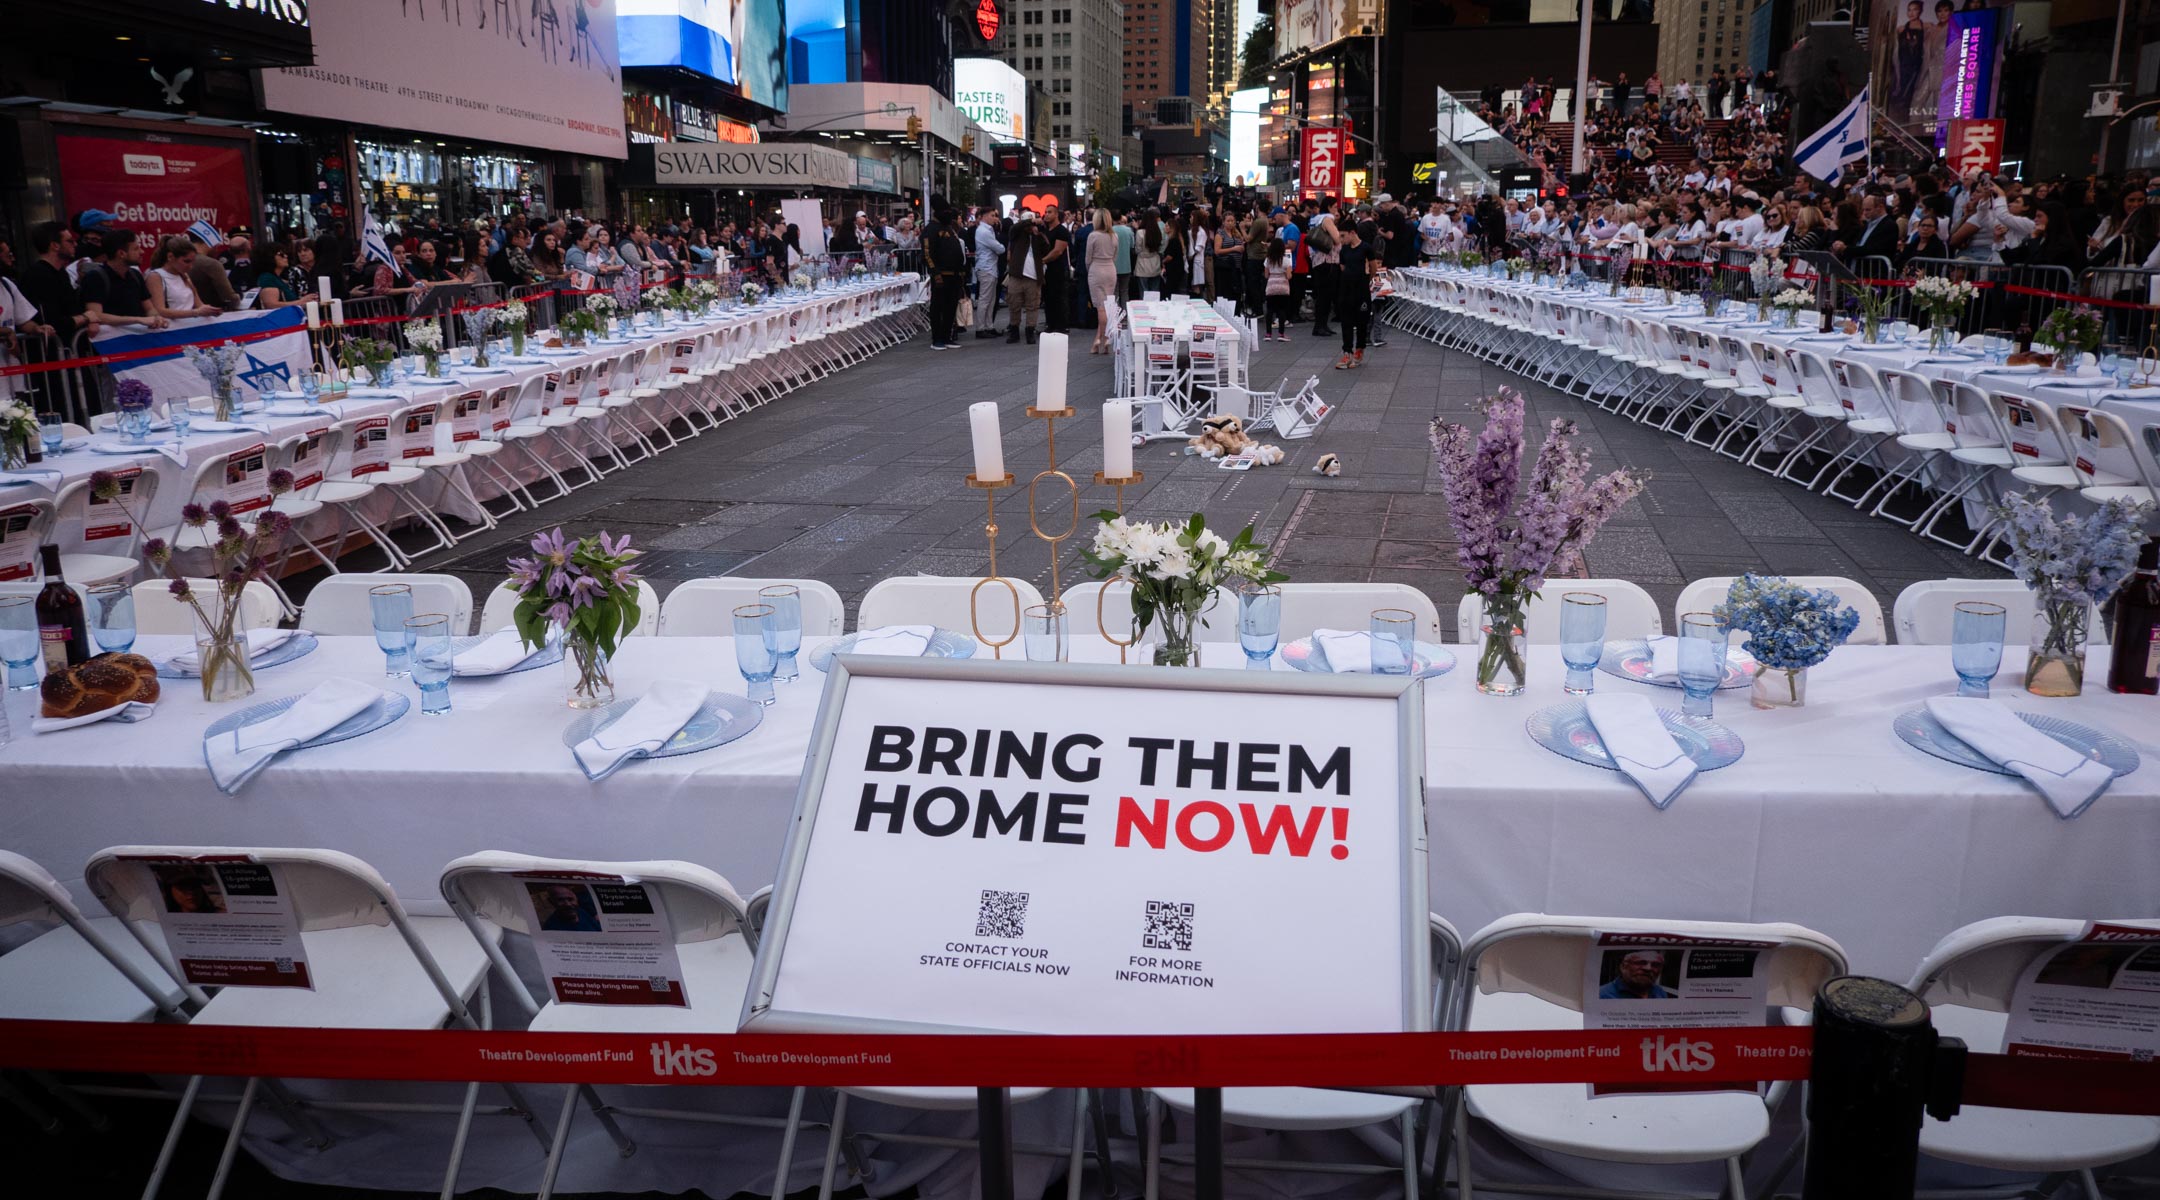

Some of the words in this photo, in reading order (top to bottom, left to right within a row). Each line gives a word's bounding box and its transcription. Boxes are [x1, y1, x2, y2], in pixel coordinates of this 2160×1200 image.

[1960, 28, 1970, 57] BETTER
[1966, 27, 1980, 79] SQUARE
[1958, 66, 1966, 81] FOR
[288, 66, 351, 86] AMBASSADOR
[354, 78, 389, 93] THEATRE
[397, 86, 416, 99] 49TH
[419, 90, 443, 104] STREET
[446, 96, 454, 104] AT
[456, 98, 490, 112] BROADWAY
[957, 91, 992, 103] TASTE
[1954, 82, 1964, 117] OALITION
[681, 104, 703, 127] BLUE
[658, 152, 809, 175] SWAROVSKI
[1310, 131, 1338, 187] tkts
[114, 201, 145, 222] Get
[146, 201, 218, 226] Broadway
[864, 725, 1104, 784] BRING
[1127, 736, 1351, 796] THEM
[854, 783, 1090, 845] HOME
[1115, 796, 1350, 861] NOW!
[945, 942, 1008, 957] CONTACT
[1011, 946, 1050, 960] YOUR
[1609, 935, 1768, 948] KIDNAPPED
[189, 962, 212, 970] Please
[212, 963, 230, 971] help
[230, 965, 249, 973] bring
[919, 954, 959, 969] STATE
[962, 957, 1032, 974] OFFICIALS
[1033, 962, 1071, 977] NOW
[1129, 955, 1155, 970] FOR
[1157, 957, 1203, 972] MORE
[561, 981, 585, 989] Please
[586, 982, 601, 991] help
[602, 982, 621, 992] bring
[1115, 970, 1214, 988] INFORMATION
[479, 1049, 523, 1063] Theatre
[525, 1050, 602, 1065] Development
[603, 1048, 634, 1062] Fund
[650, 1041, 718, 1077] tkts
[733, 1051, 778, 1064] Theatre
[781, 1051, 858, 1066] Development
[861, 1052, 892, 1065] Fund
[1449, 1048, 1498, 1061] Theatre
[1500, 1047, 1585, 1062] Development
[1588, 1045, 1620, 1058] Fund
[1640, 1035, 1716, 1073] tkts
[1735, 1045, 1786, 1058] Theatre
